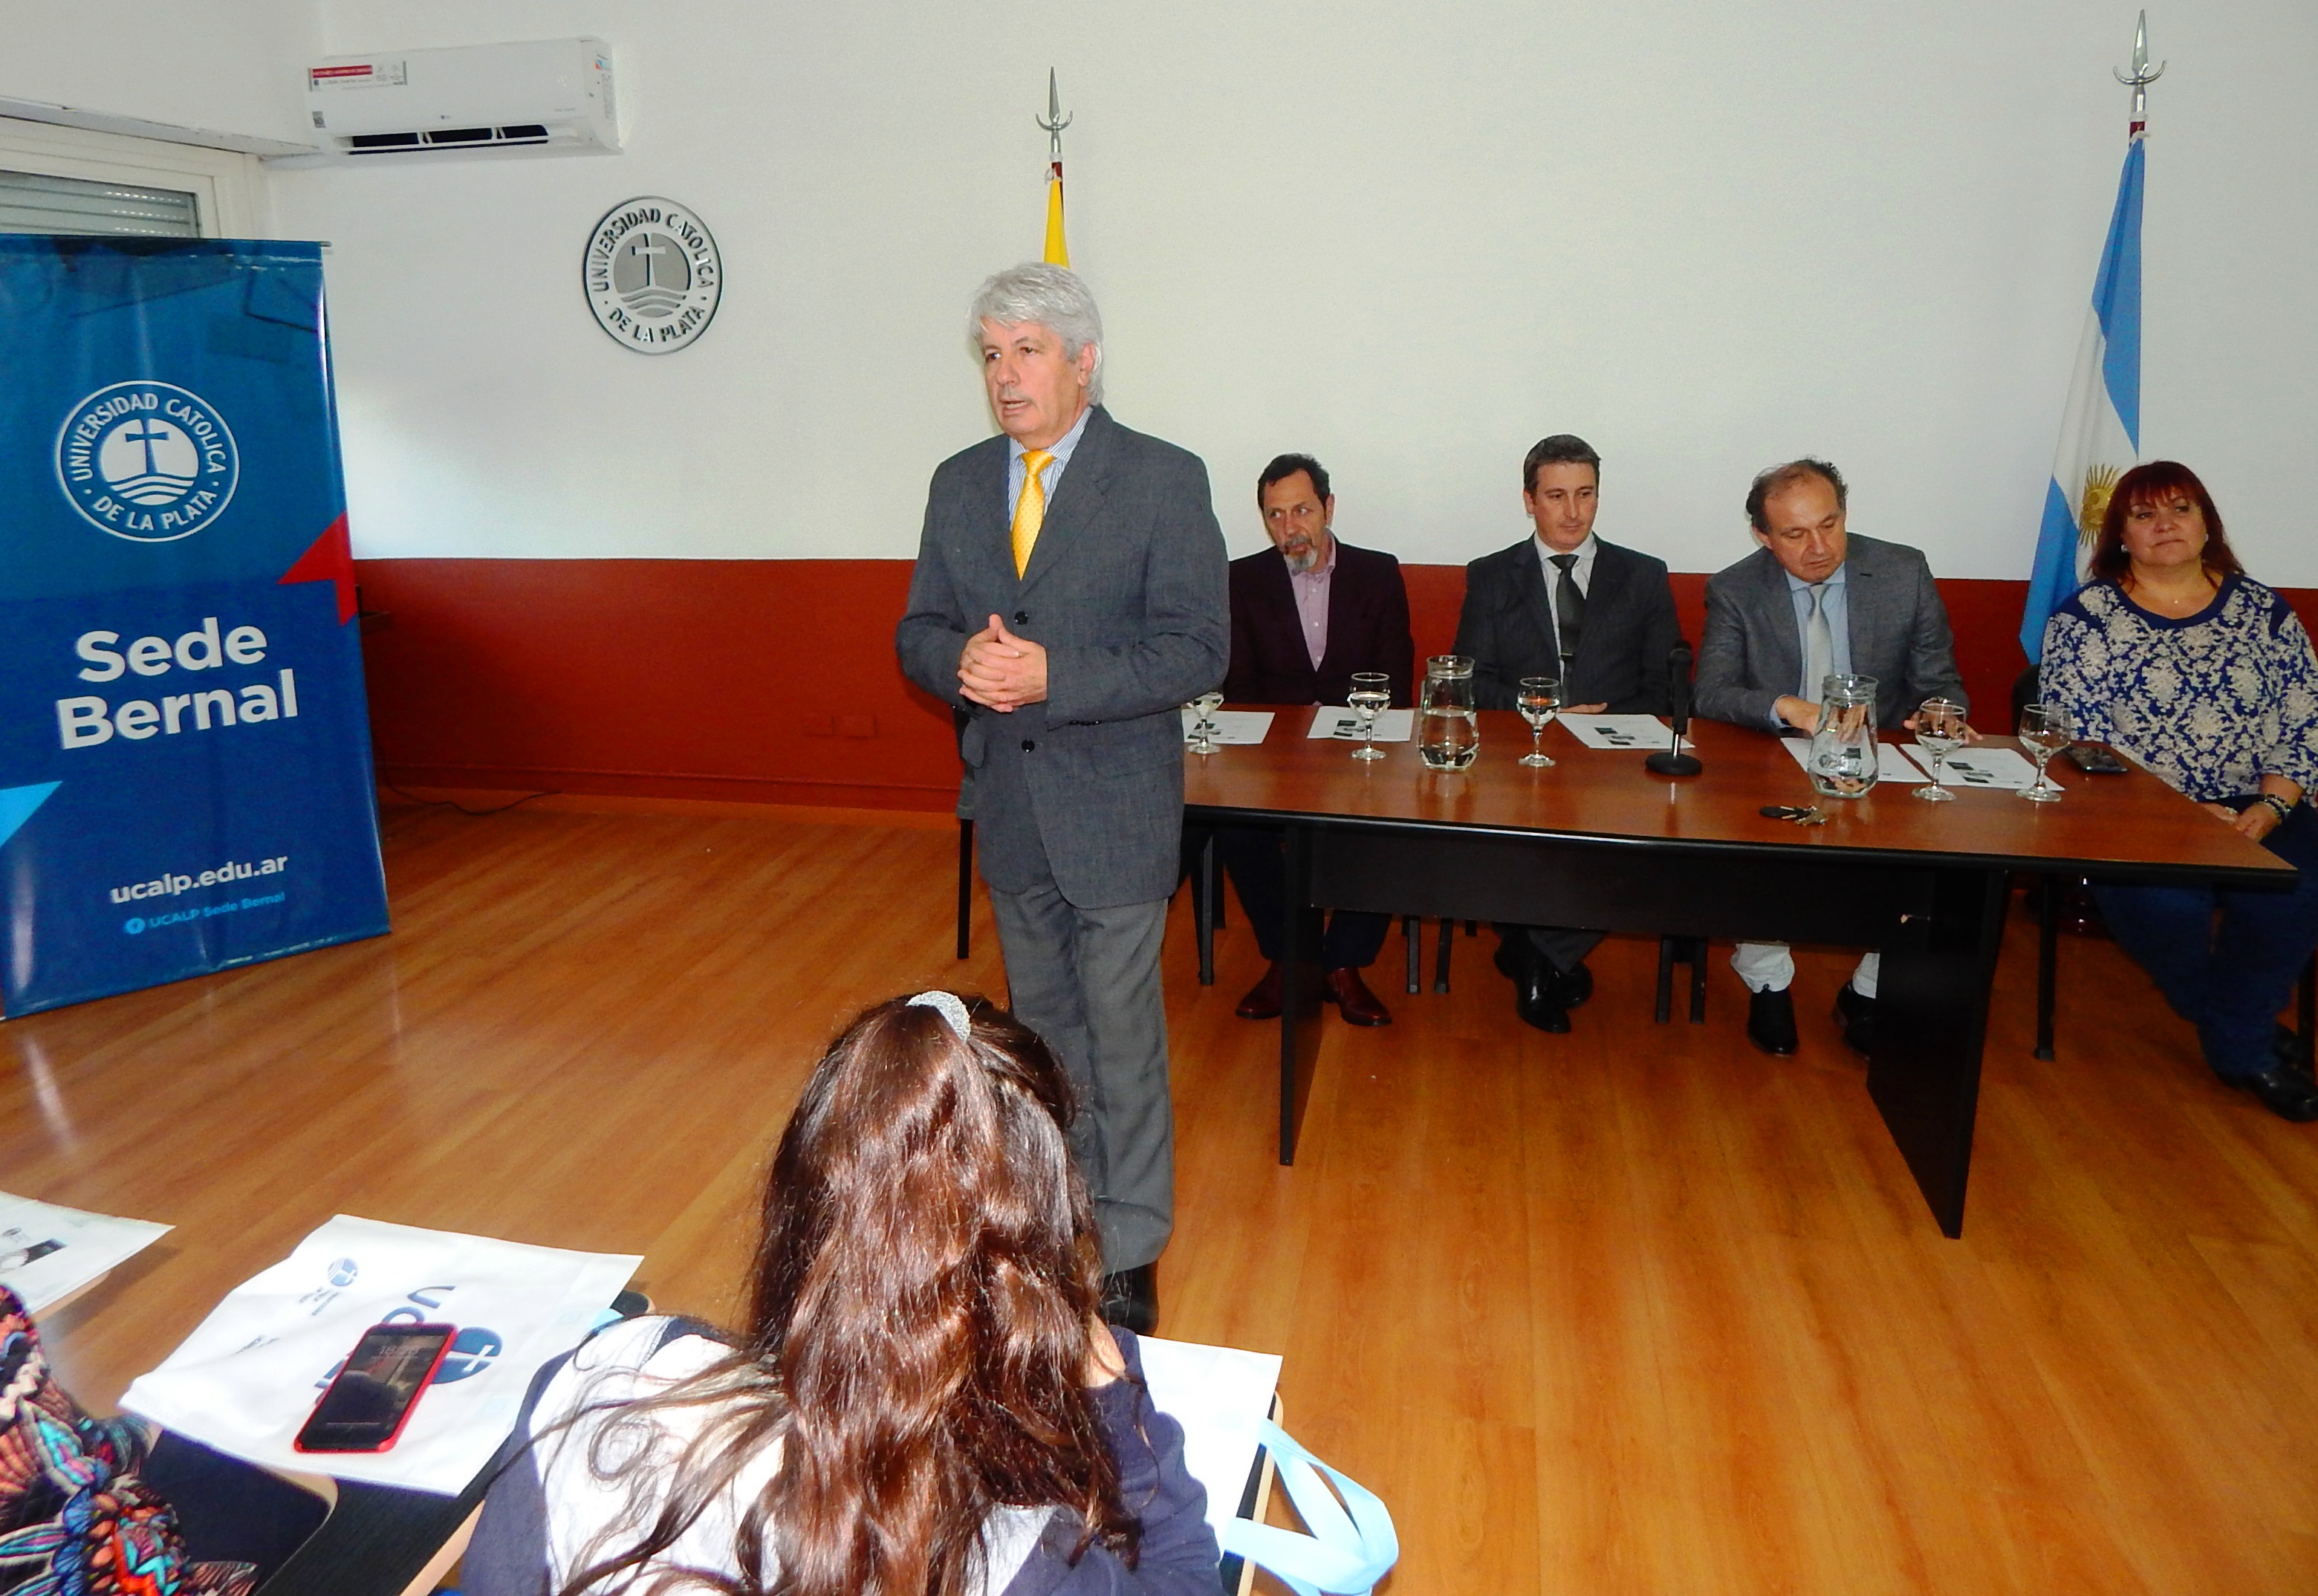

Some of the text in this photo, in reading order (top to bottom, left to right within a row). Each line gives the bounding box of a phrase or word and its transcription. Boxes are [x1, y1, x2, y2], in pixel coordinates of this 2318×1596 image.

[591, 208, 714, 292] UNIVERSIDAD CATOLICA
[608, 305, 705, 343] DE LA PLATA
[69, 392, 227, 481] UNIVERSIDAD CATOLICA
[92, 490, 217, 531] DE LA PLATA
[76, 617, 267, 683] Sede
[56, 669, 298, 750] Bernal
[111, 855, 288, 904] ucalp.edu.ar
[149, 892, 286, 927] UCALP Sede Bernal
